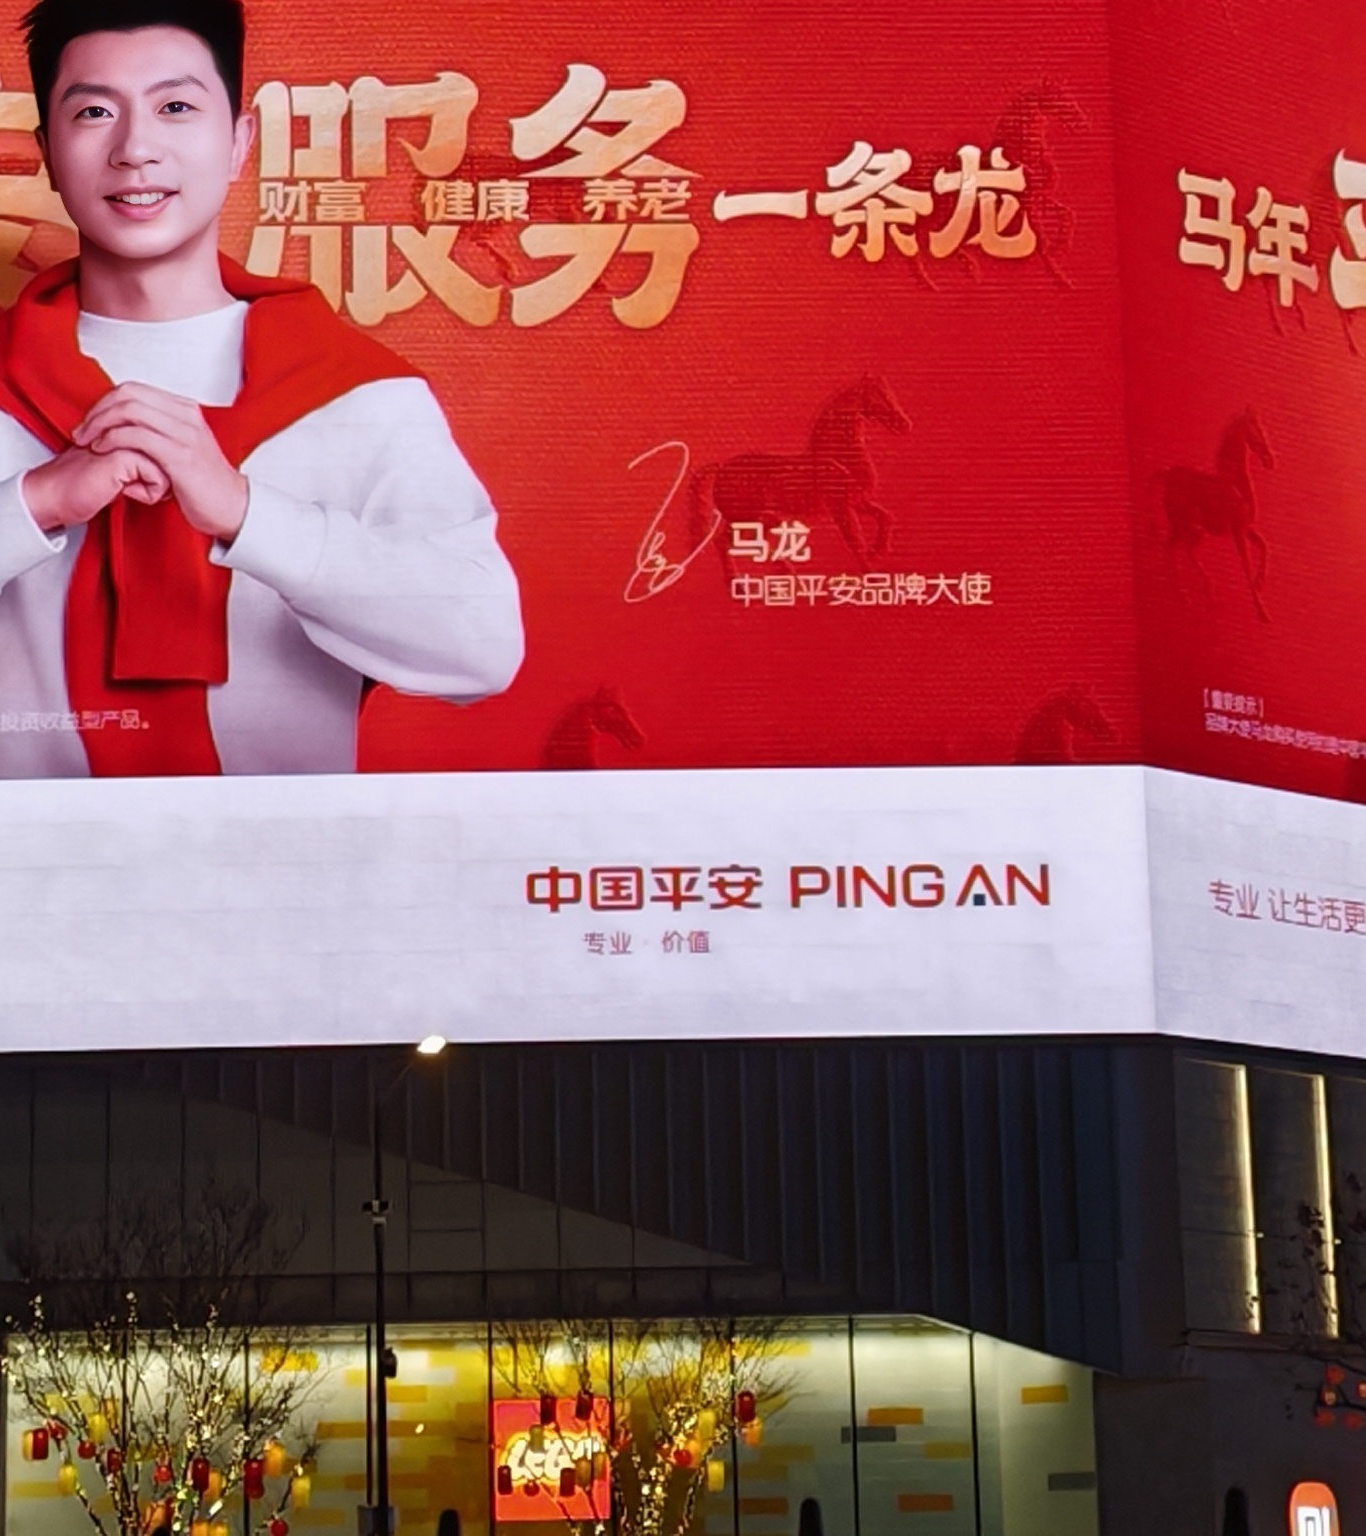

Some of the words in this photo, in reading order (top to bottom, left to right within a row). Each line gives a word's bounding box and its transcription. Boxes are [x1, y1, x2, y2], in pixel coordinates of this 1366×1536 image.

[259, 179, 368, 223] 财富
[421, 178, 530, 222] 健康
[582, 177, 692, 222] 养老
[728, 520, 812, 564] 马龙
[731, 572, 994, 608] 中国平安品牌大使
[526, 865, 764, 913] 中国平安
[1208, 878, 1262, 921] 专业
